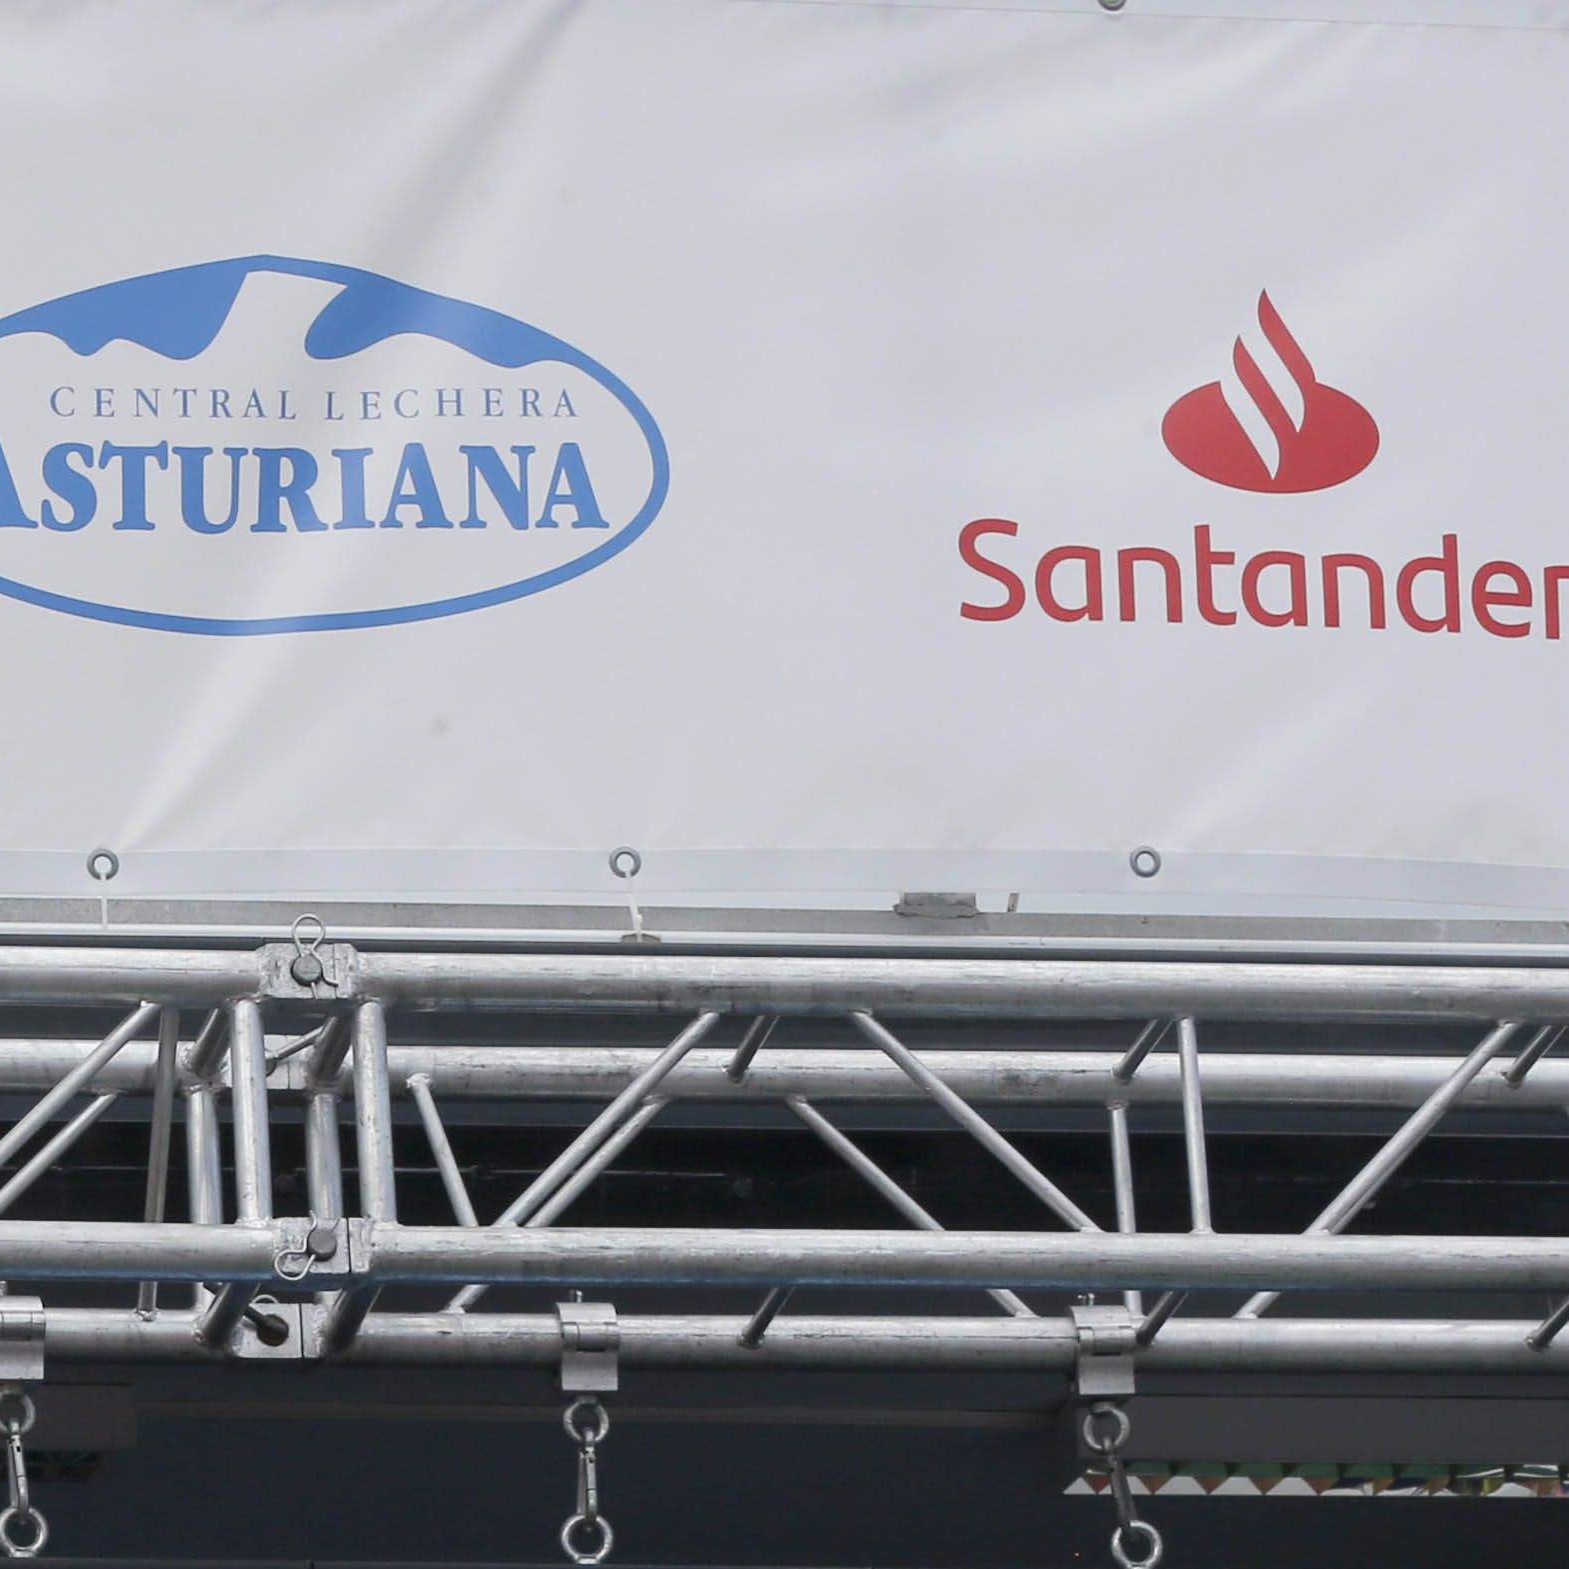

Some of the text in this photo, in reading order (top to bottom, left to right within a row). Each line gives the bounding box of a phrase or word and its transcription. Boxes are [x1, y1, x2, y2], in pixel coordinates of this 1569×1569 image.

[48, 386, 581, 420] CENTRAL LECHERA
[958, 518, 1569, 641] Santander
